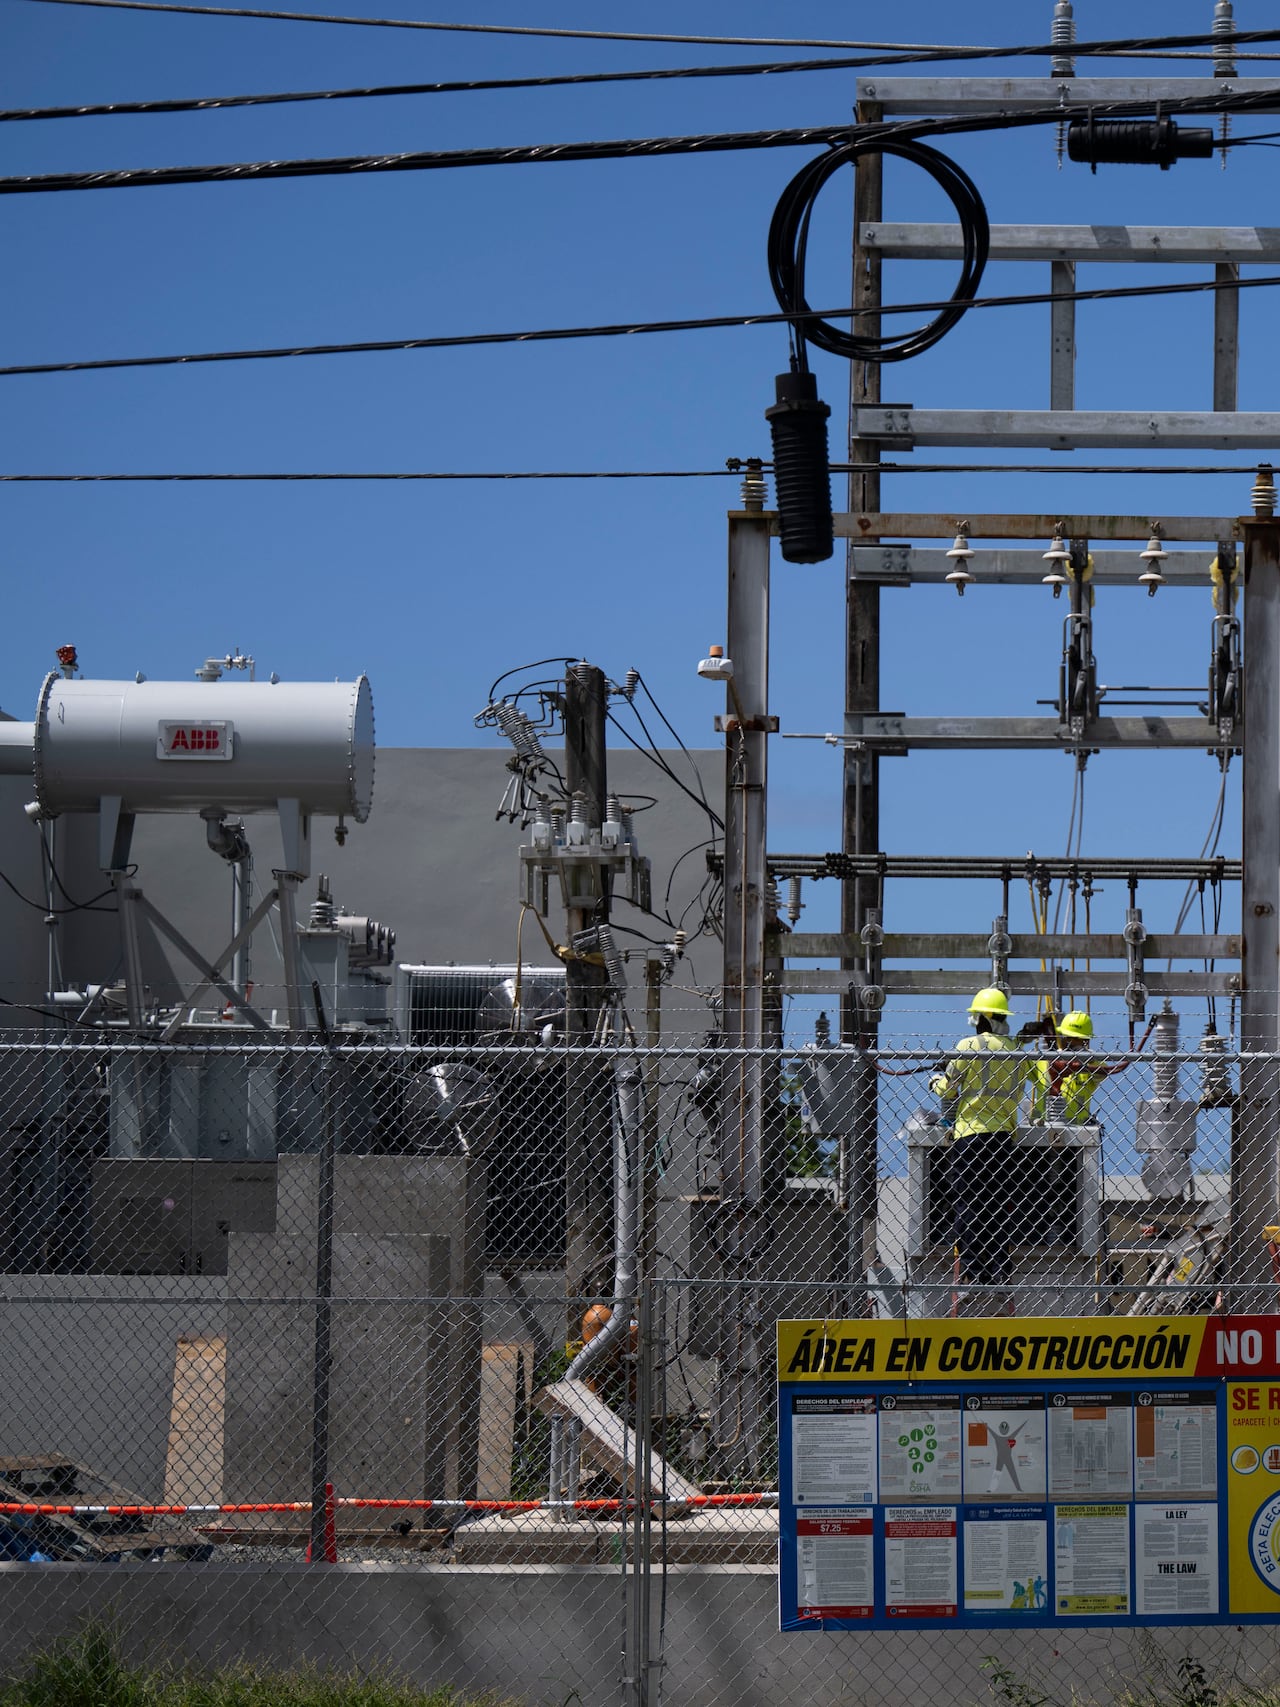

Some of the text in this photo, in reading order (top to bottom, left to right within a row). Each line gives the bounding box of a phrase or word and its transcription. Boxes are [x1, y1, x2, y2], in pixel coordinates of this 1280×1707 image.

[171, 729, 219, 750] ABB
[787, 1325, 1191, 1373] ÁREA EN CONSTRUCCIÓN
[1217, 1329, 1263, 1365] NO
[1232, 1387, 1260, 1411] SE
[1232, 1418, 1265, 1426] CAPACETE
[909, 1485, 931, 1493] OSHA
[1165, 1510, 1188, 1519] LA LEY
[820, 1524, 841, 1532] $7.25
[1258, 1540, 1277, 1573] BETA
[1158, 1563, 1197, 1574] THE LAW
